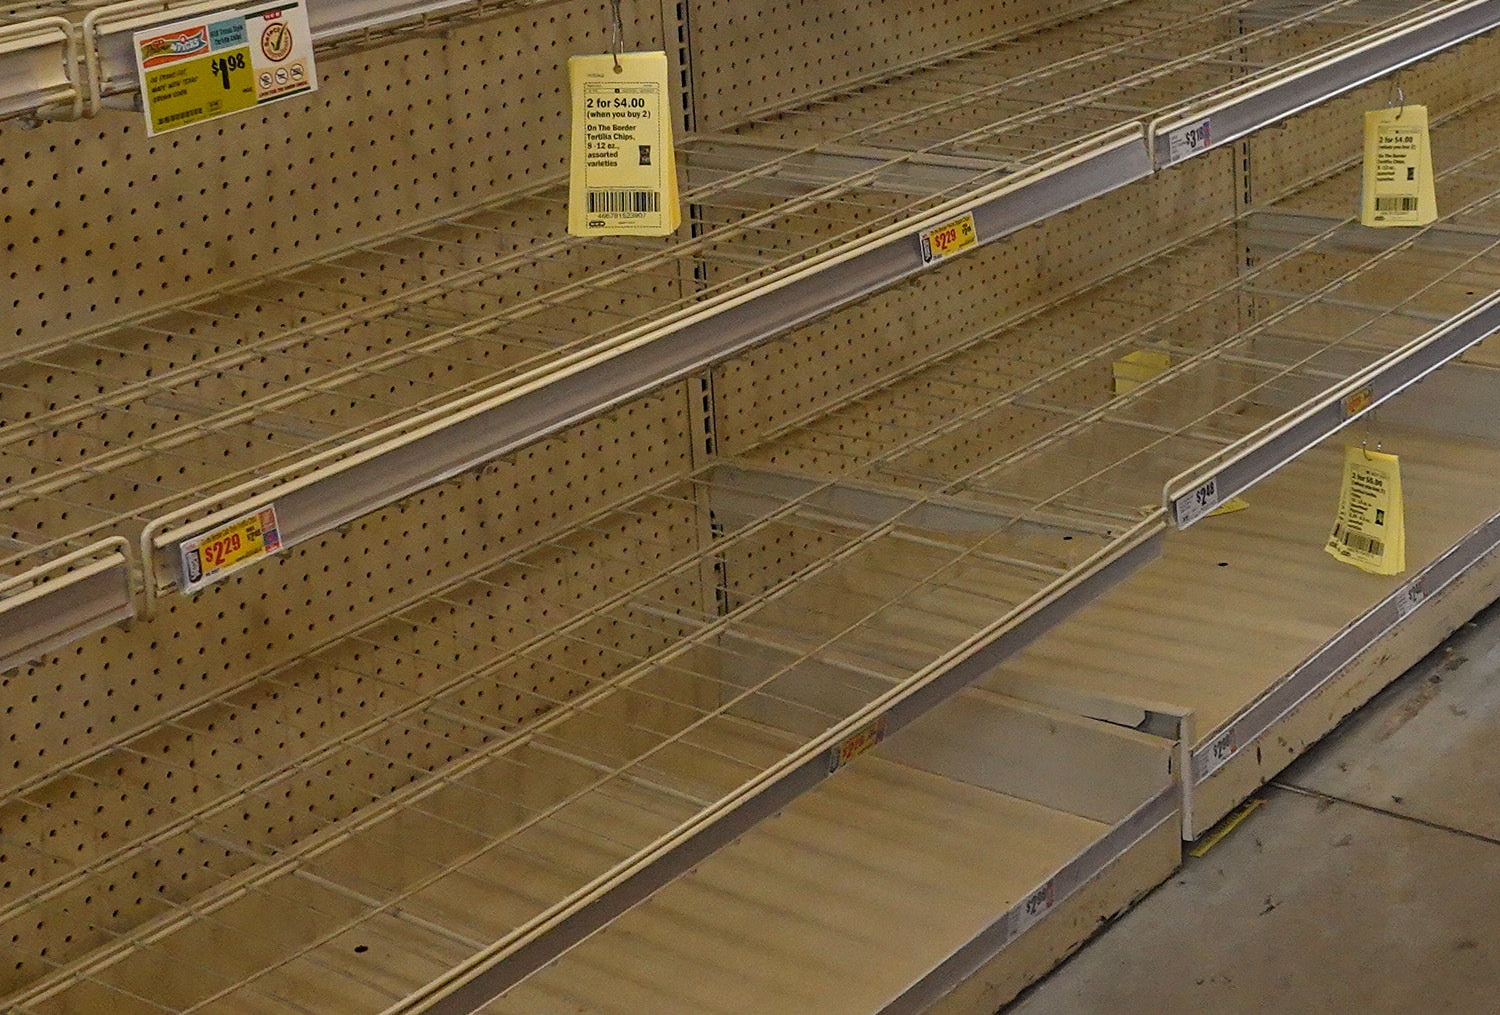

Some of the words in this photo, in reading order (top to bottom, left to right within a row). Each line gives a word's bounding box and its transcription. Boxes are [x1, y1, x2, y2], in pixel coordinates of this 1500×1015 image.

[587, 98, 593, 108] 2
[597, 98, 611, 108] for
[614, 97, 645, 108] $4.00
[587, 111, 610, 119] (when
[612, 112, 625, 120] you
[627, 111, 640, 120] buy
[642, 110, 651, 119] 2)
[204, 533, 241, 566] $229
